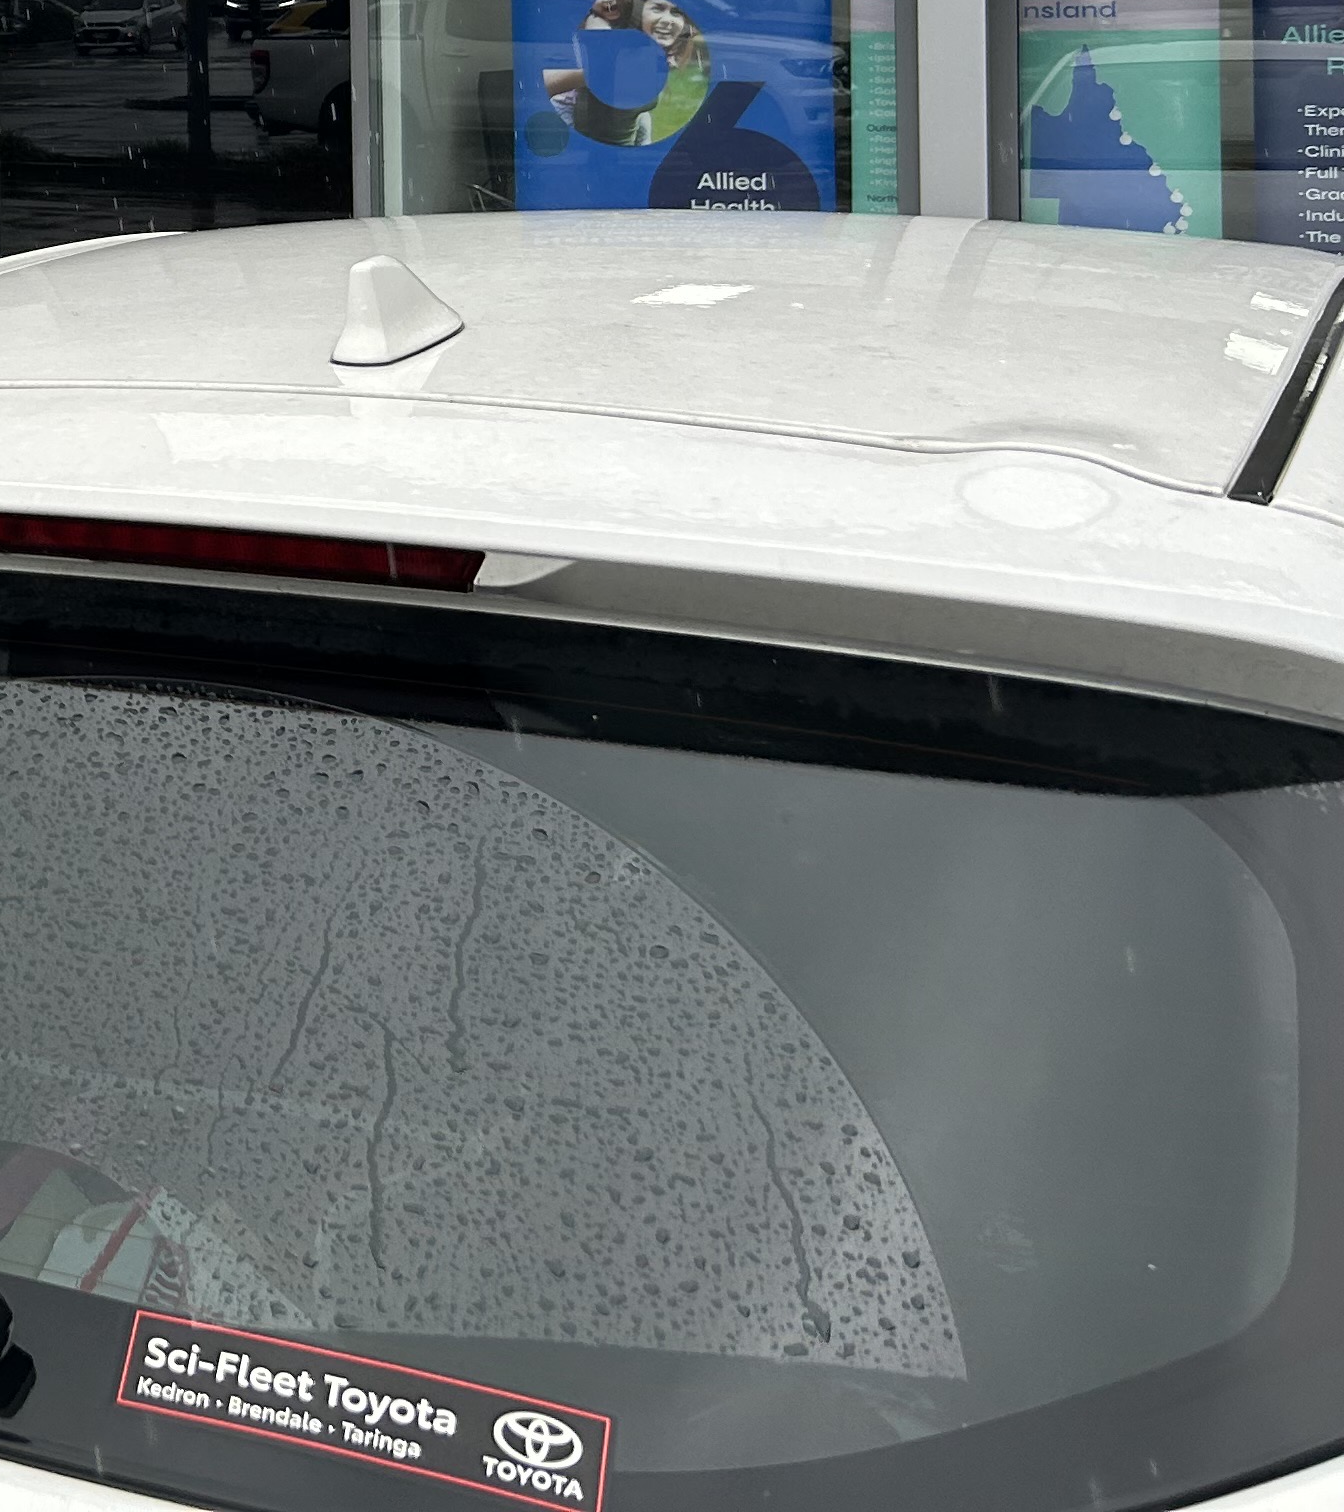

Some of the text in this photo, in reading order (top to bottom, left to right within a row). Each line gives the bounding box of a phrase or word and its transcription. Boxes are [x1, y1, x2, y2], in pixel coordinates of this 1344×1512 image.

[697, 172, 767, 191] Allied
[1305, 167, 1338, 179] Full
[691, 199, 775, 211] Health
[1305, 230, 1341, 244] The
[144, 1336, 459, 1438] Sci-Fleet Toyota
[135, 1375, 422, 1460] Kedron Brendale Taringa
[482, 1454, 585, 1502] TOYOTA
